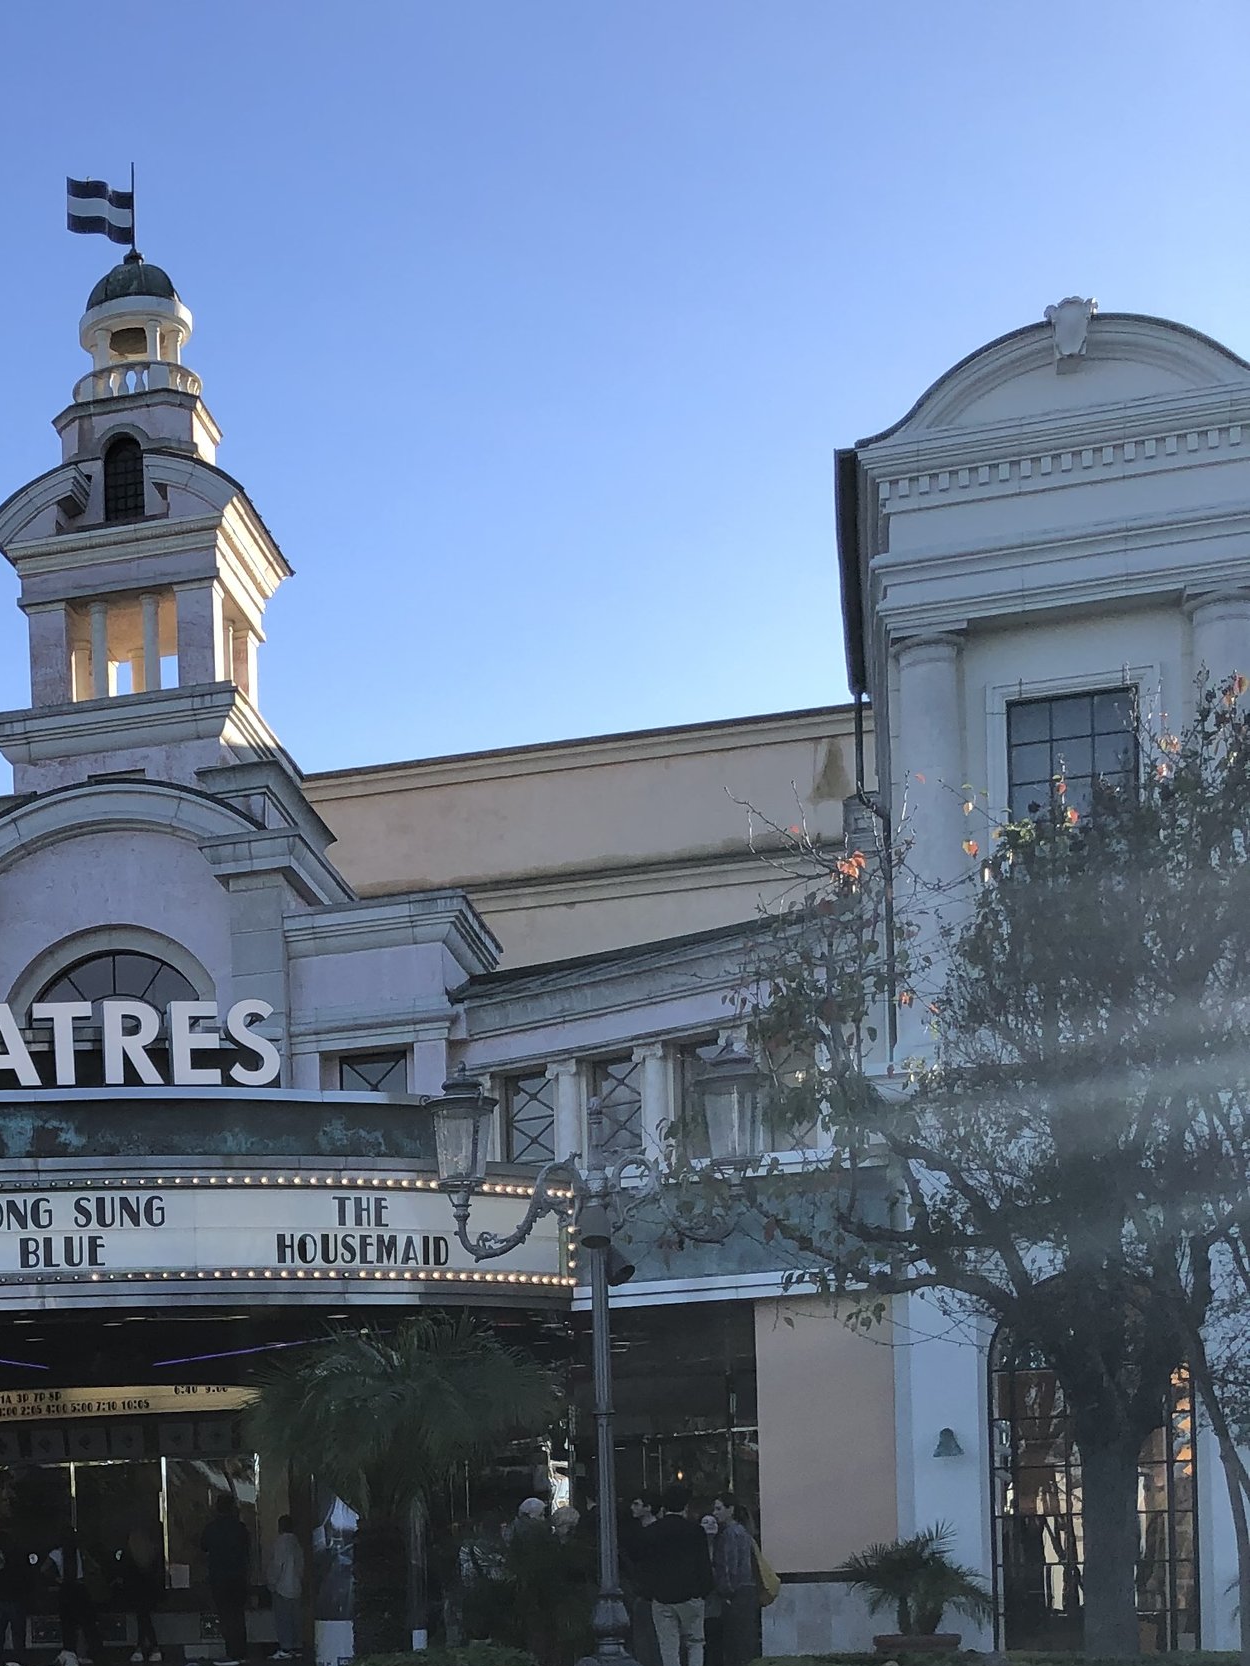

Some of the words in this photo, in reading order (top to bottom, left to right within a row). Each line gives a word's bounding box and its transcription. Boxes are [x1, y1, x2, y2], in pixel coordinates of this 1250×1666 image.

[73, 1195, 166, 1228] SUNG
[332, 1196, 389, 1227] THE
[19, 1235, 106, 1268] BLUE
[276, 1233, 449, 1267] HOUSEMAID
[71, 1402, 93, 1413] 5:00
[95, 1401, 118, 1412] 7:10
[121, 1400, 150, 1411] 10:05
